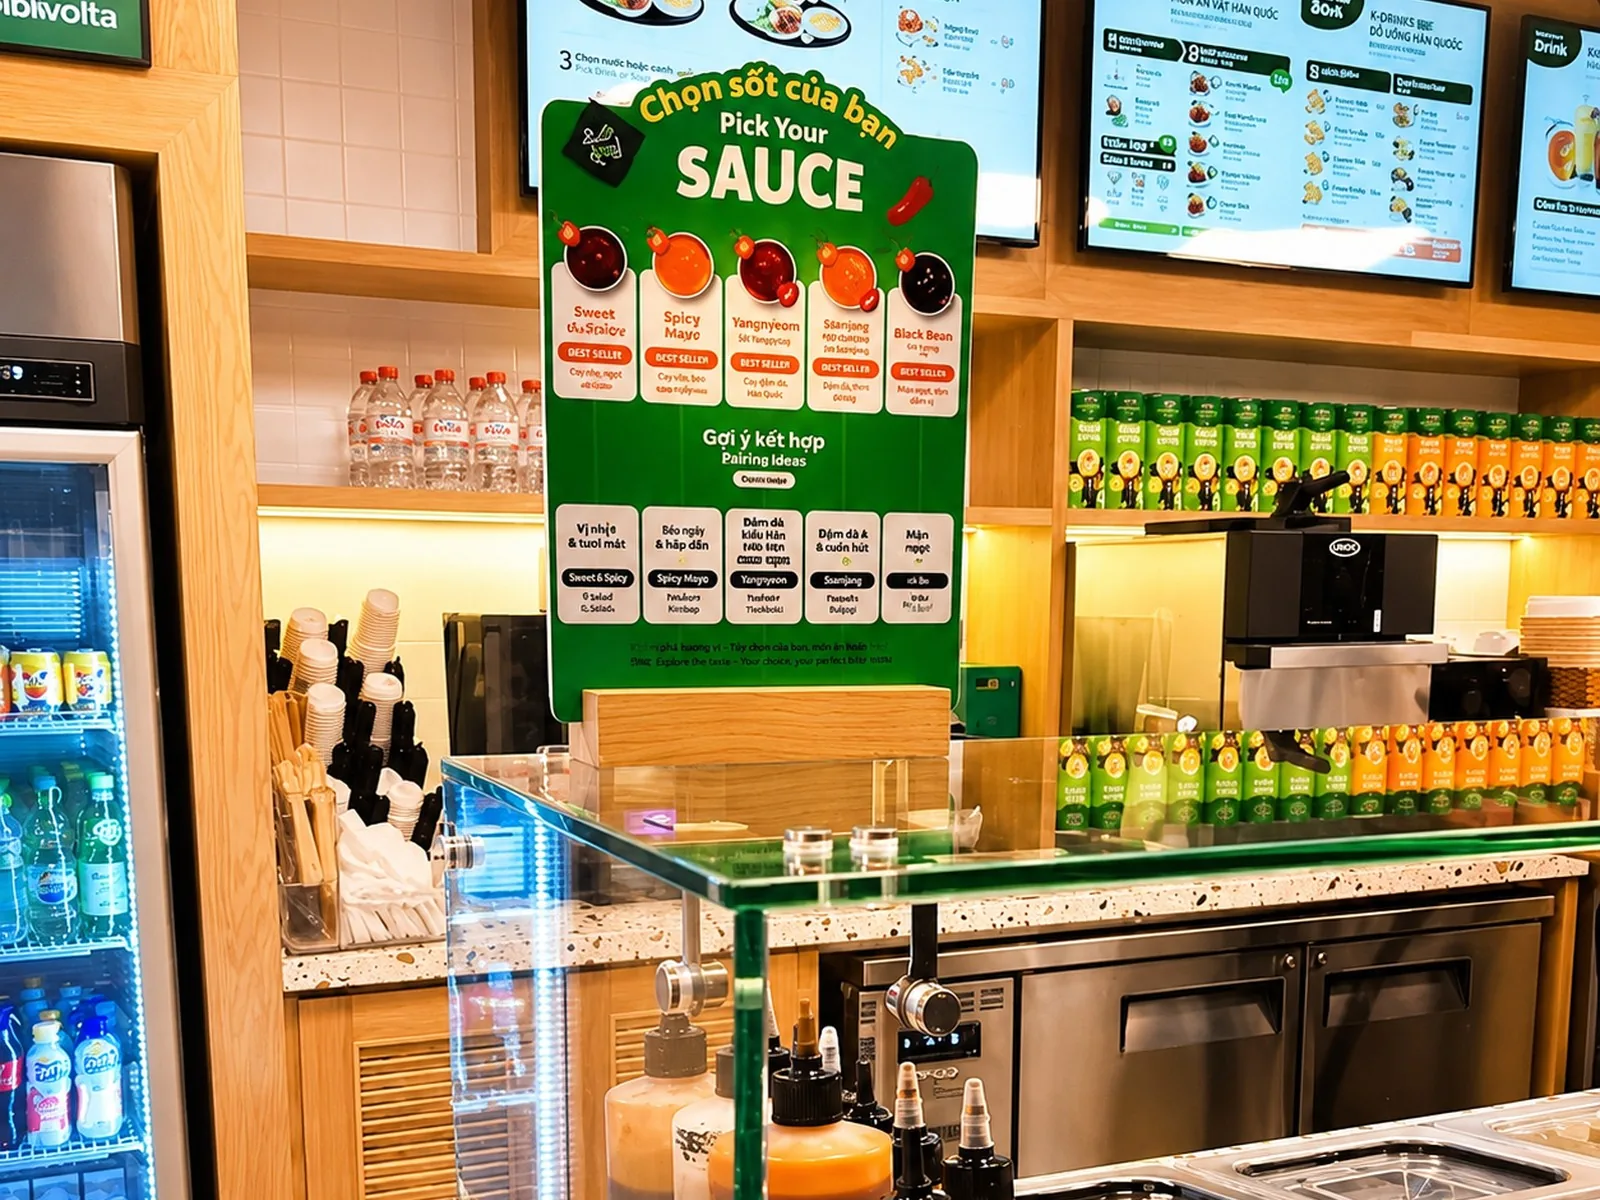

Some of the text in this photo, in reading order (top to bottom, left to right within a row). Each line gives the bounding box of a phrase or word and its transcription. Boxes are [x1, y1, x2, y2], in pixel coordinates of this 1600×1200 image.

[1534, 39, 1568, 57] Drink
[560, 50, 572, 70] 3
[575, 52, 600, 64] Chọn
[639, 67, 897, 150] Chọn sốt của bạn
[720, 112, 829, 144] Pick Your
[676, 144, 865, 213] SAUCE
[664, 311, 700, 328] Spicy
[894, 328, 953, 342] Black Bean
[702, 428, 825, 454] Gợi ý kết hợp
[722, 452, 806, 468] Pairing Ideas
[604, 573, 628, 584] Spicy
[656, 574, 709, 586] Spicy Mayo
